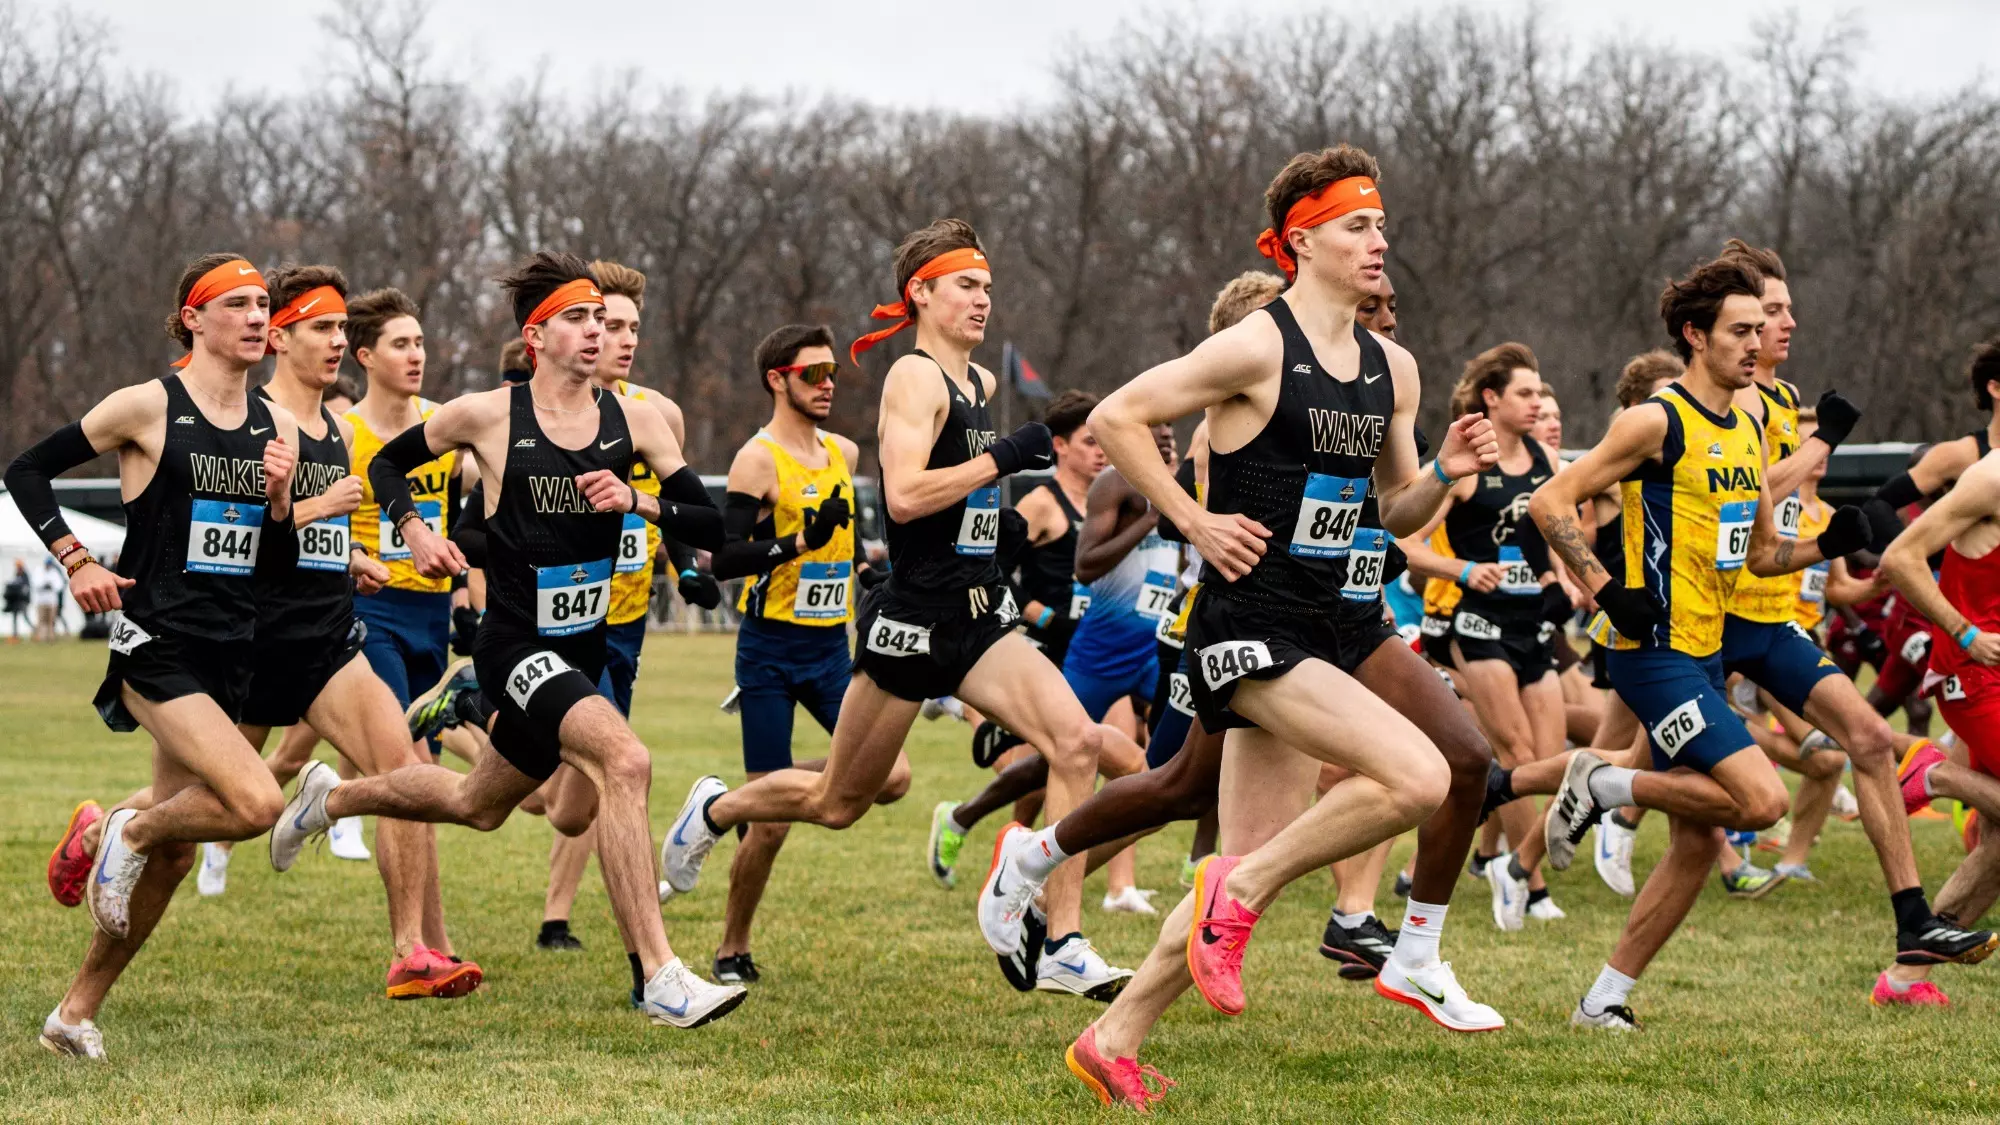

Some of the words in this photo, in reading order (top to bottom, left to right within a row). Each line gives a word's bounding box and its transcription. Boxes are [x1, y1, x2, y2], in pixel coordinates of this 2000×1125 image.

[1292, 364, 1311, 374] ACC
[175, 416, 195, 424] ACC
[1308, 408, 1385, 457] WAKE
[514, 439, 537, 447] ACC
[190, 452, 267, 498] WAKE
[406, 472, 446, 496] AU
[971, 513, 997, 541] 842
[1310, 507, 1358, 541] 846
[1782, 501, 1798, 528] 67
[203, 528, 252, 560] 844
[302, 527, 343, 557] 850
[1729, 527, 1750, 555] 67
[552, 586, 603, 621] 847
[806, 583, 844, 607] 670
[875, 625, 920, 653] 842
[513, 656, 554, 695] 847
[1207, 646, 1259, 682] 846
[1661, 711, 1694, 748] 676
